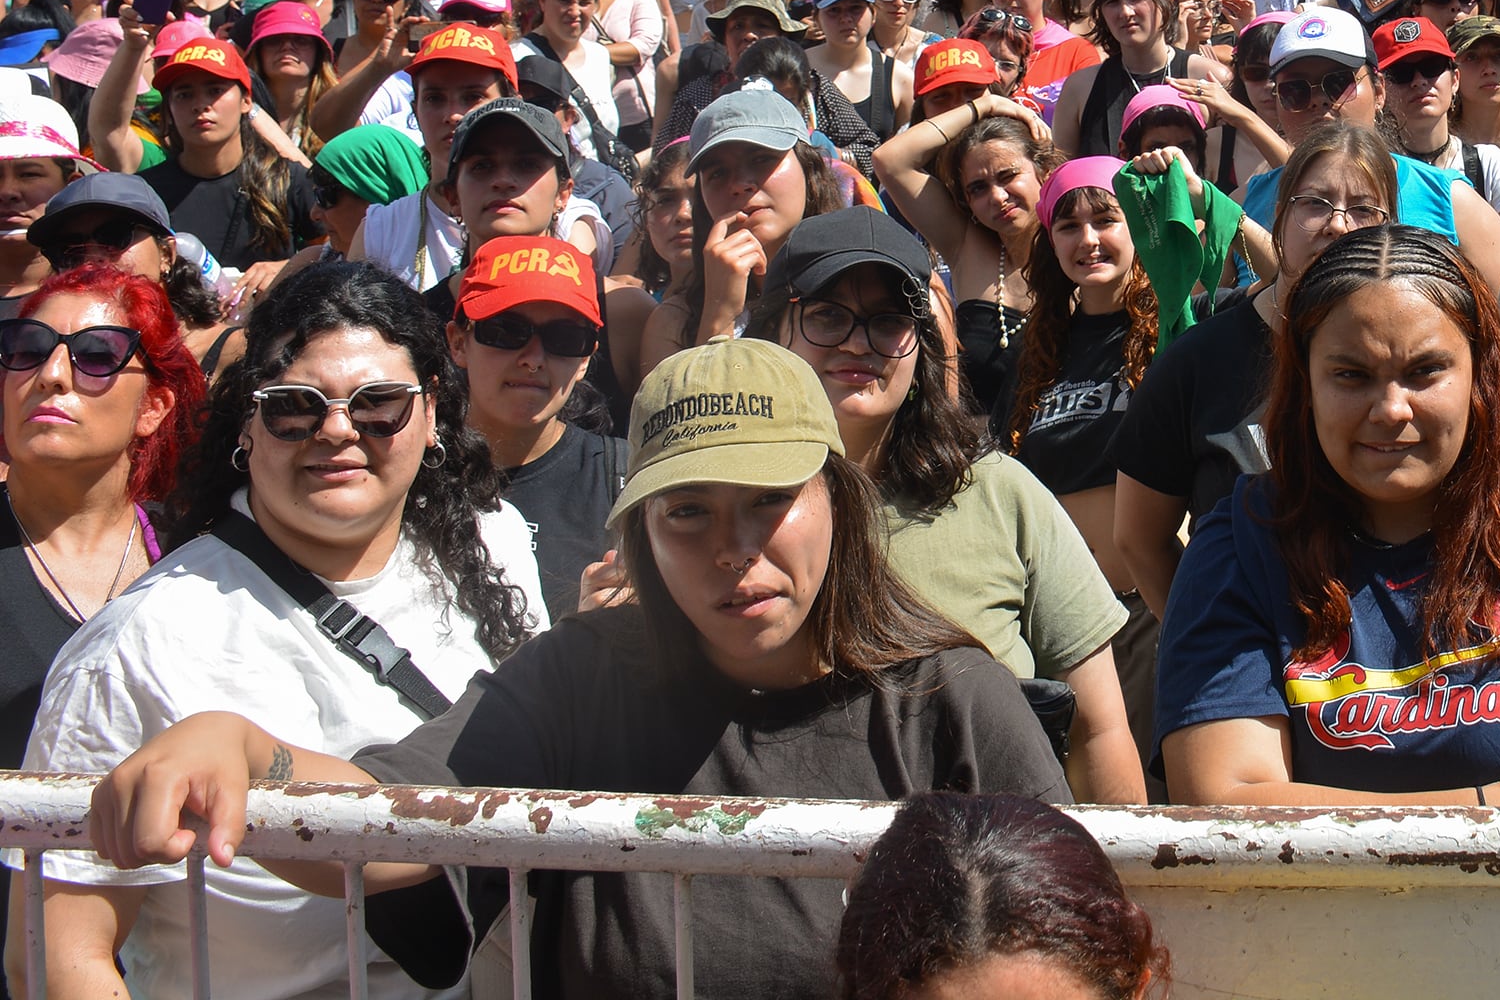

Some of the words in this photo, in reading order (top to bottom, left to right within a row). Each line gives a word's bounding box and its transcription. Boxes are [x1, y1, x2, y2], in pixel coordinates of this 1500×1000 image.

[424, 27, 472, 56] JCR
[925, 48, 961, 77] JCR
[489, 247, 550, 281] PCR
[662, 420, 738, 448] California
